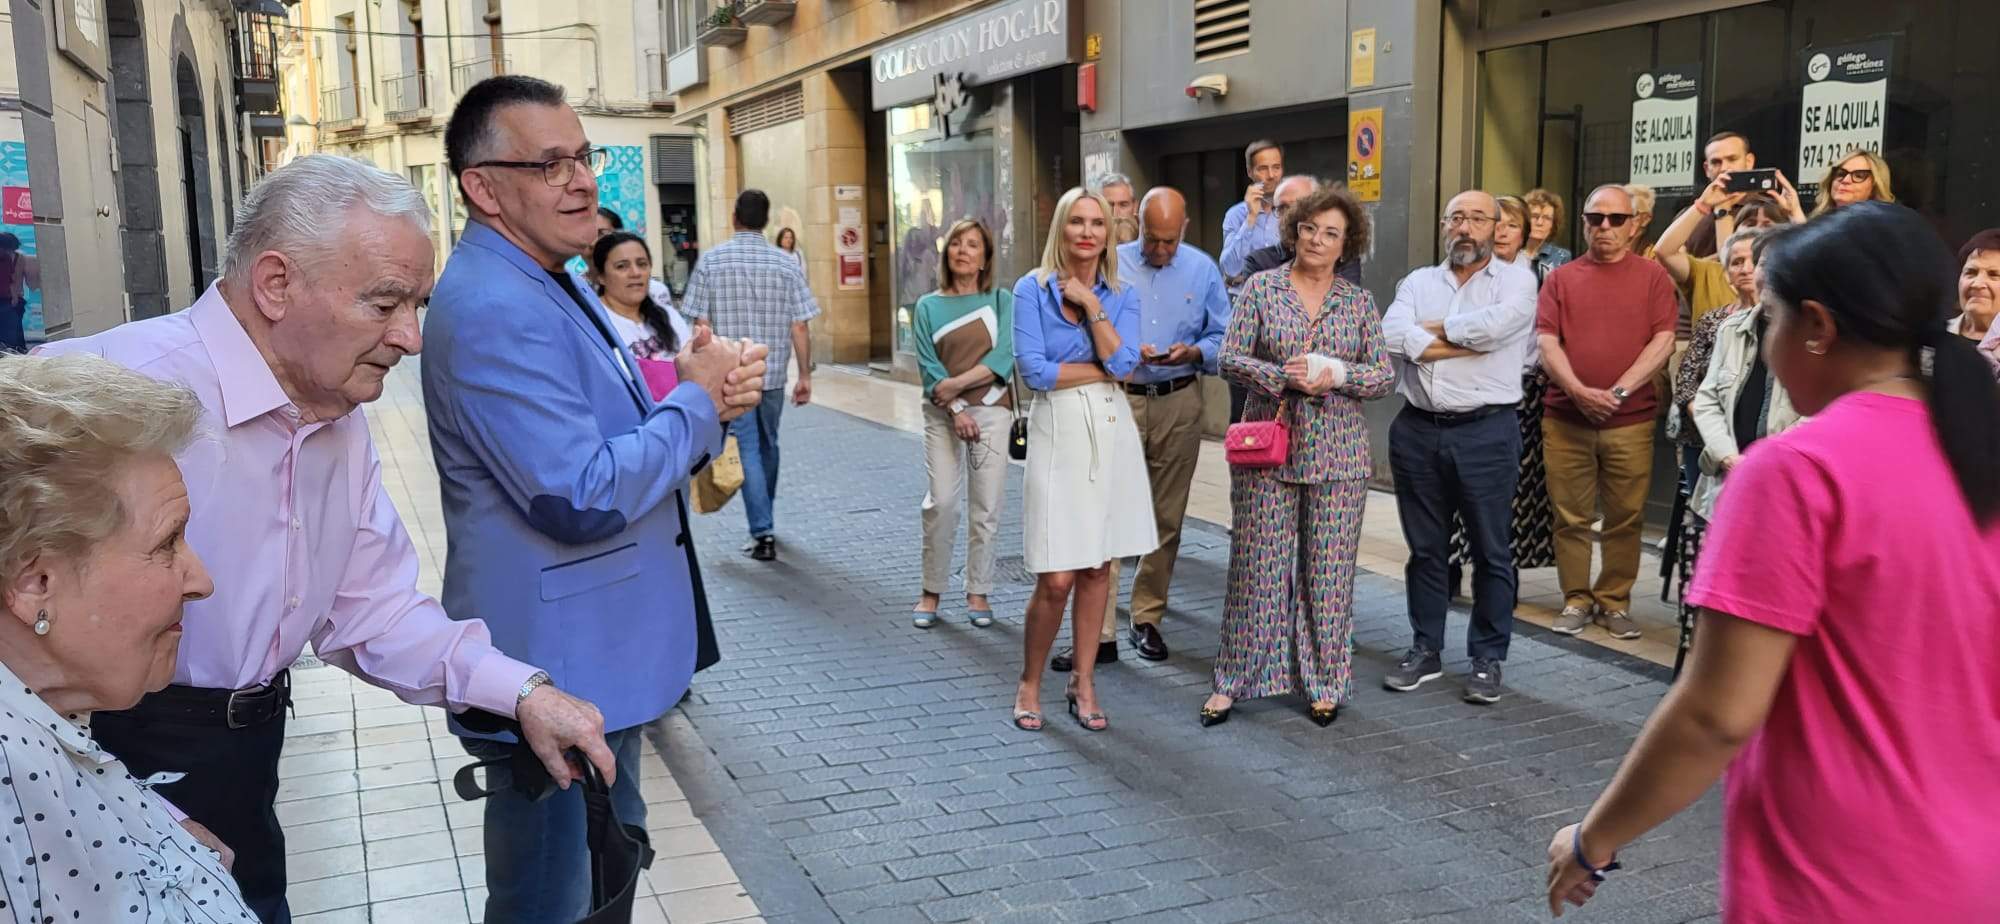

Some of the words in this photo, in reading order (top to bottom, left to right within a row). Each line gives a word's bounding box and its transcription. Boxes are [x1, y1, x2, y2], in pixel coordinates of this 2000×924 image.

[875, 26, 972, 83] COLECCION
[978, 0, 1061, 53] HOGAR
[1634, 120, 1647, 144] SE
[1649, 115, 1693, 142] ALQUILA
[1805, 106, 1821, 133] SE
[1824, 100, 1880, 132] ALQUILA
[1633, 154, 1650, 175] 974
[1652, 153, 1663, 174] 23
[1665, 152, 1678, 173] 84
[1681, 150, 1693, 172] 19
[1803, 144, 1823, 168] 974
